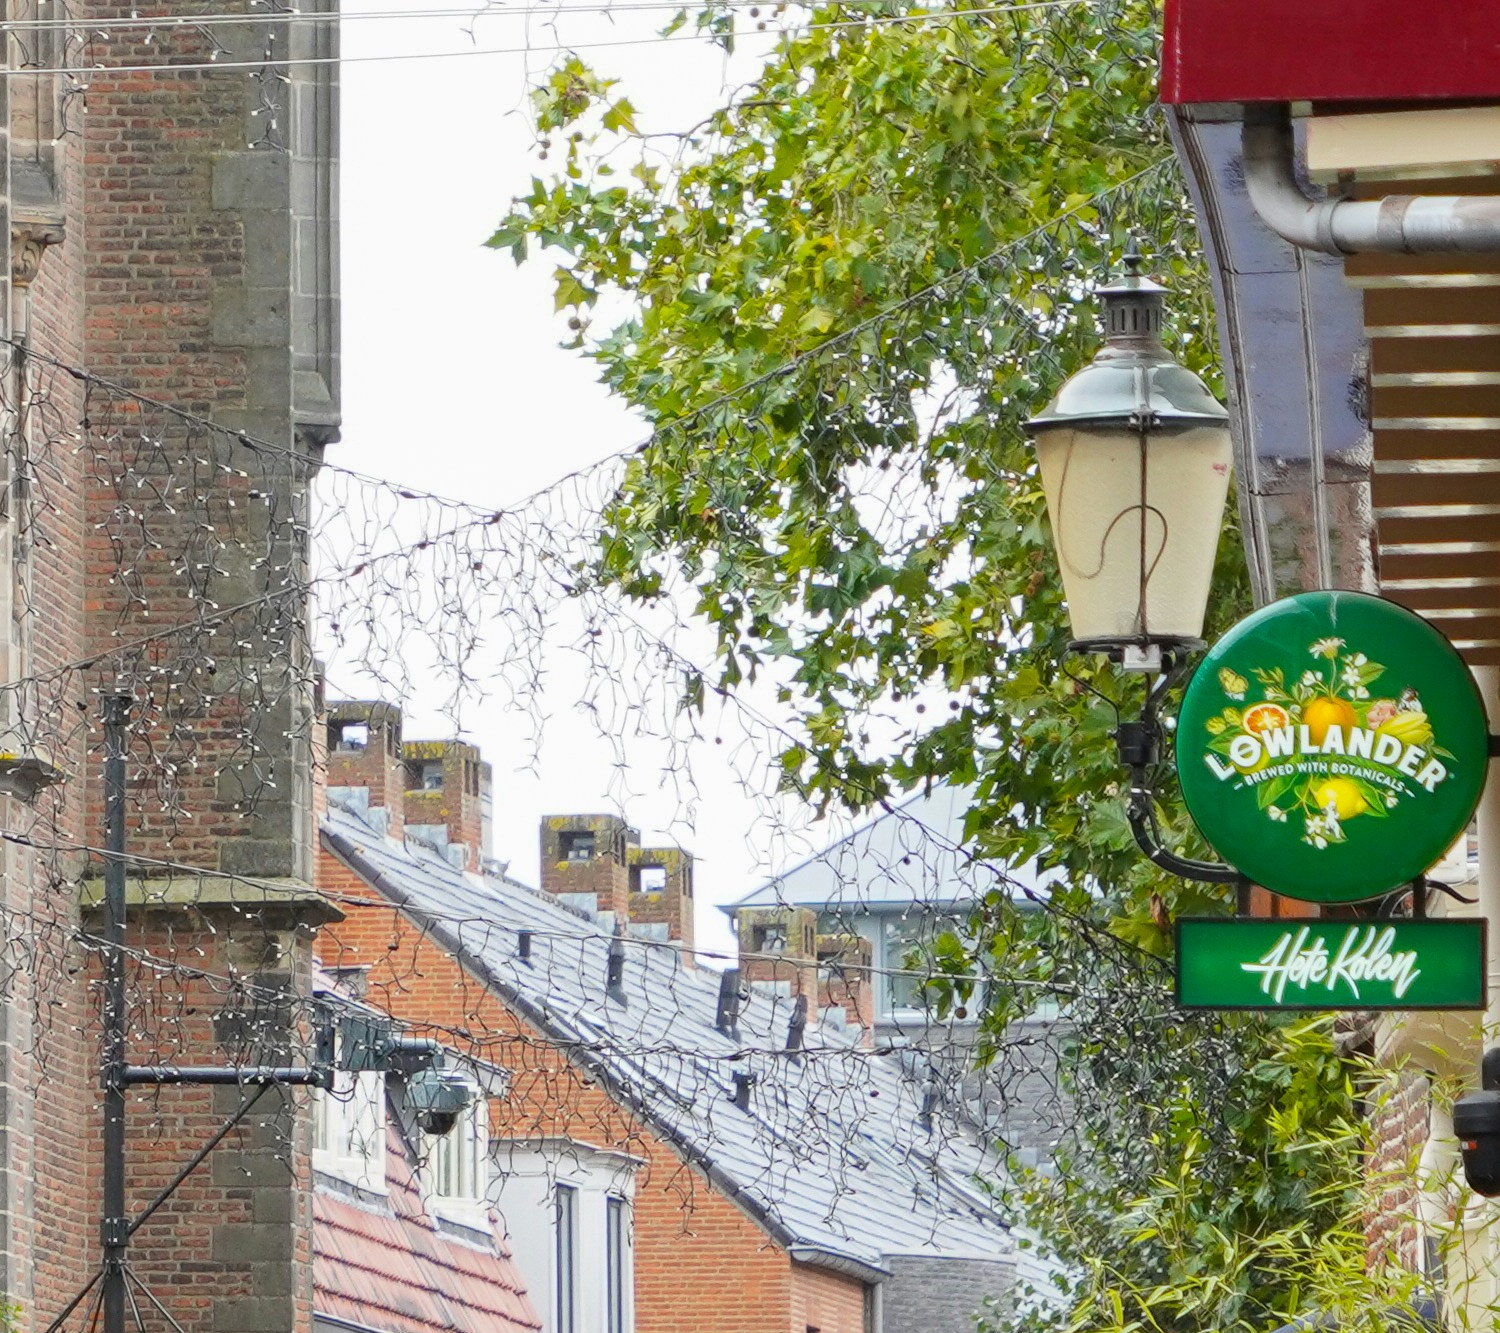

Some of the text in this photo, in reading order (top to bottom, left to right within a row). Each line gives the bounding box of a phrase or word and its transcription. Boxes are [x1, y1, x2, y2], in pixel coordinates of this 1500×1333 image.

[1204, 724, 1448, 794] LOWLANDER
[1244, 761, 1405, 793] BREWED WITH BOTANICALS
